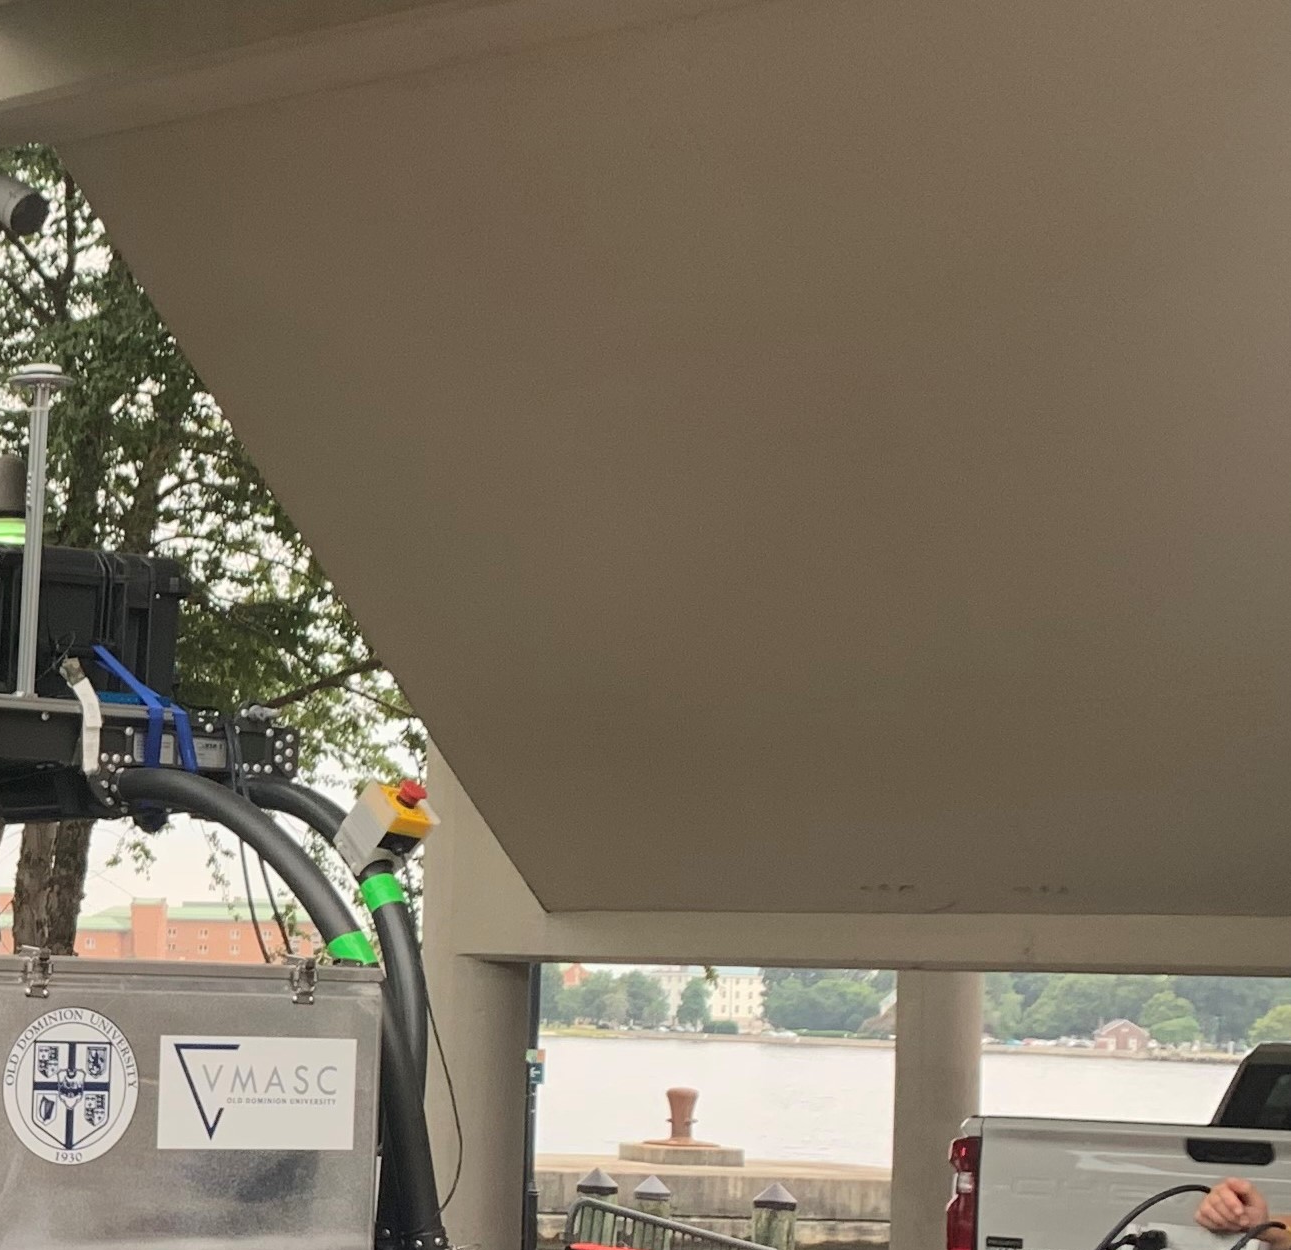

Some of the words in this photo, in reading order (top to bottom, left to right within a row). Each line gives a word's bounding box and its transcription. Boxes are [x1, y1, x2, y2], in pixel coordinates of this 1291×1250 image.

[5, 1053, 19, 1087] OLD
[17, 1009, 84, 1051] DOMINION
[89, 1013, 139, 1089] UNIVERSITY
[202, 1063, 338, 1095] VMASC
[226, 1097, 243, 1105] OLD
[245, 1097, 287, 1106] DOMINION
[290, 1097, 337, 1106] UNIVERSITY
[55, 1151, 83, 1163] 1930
